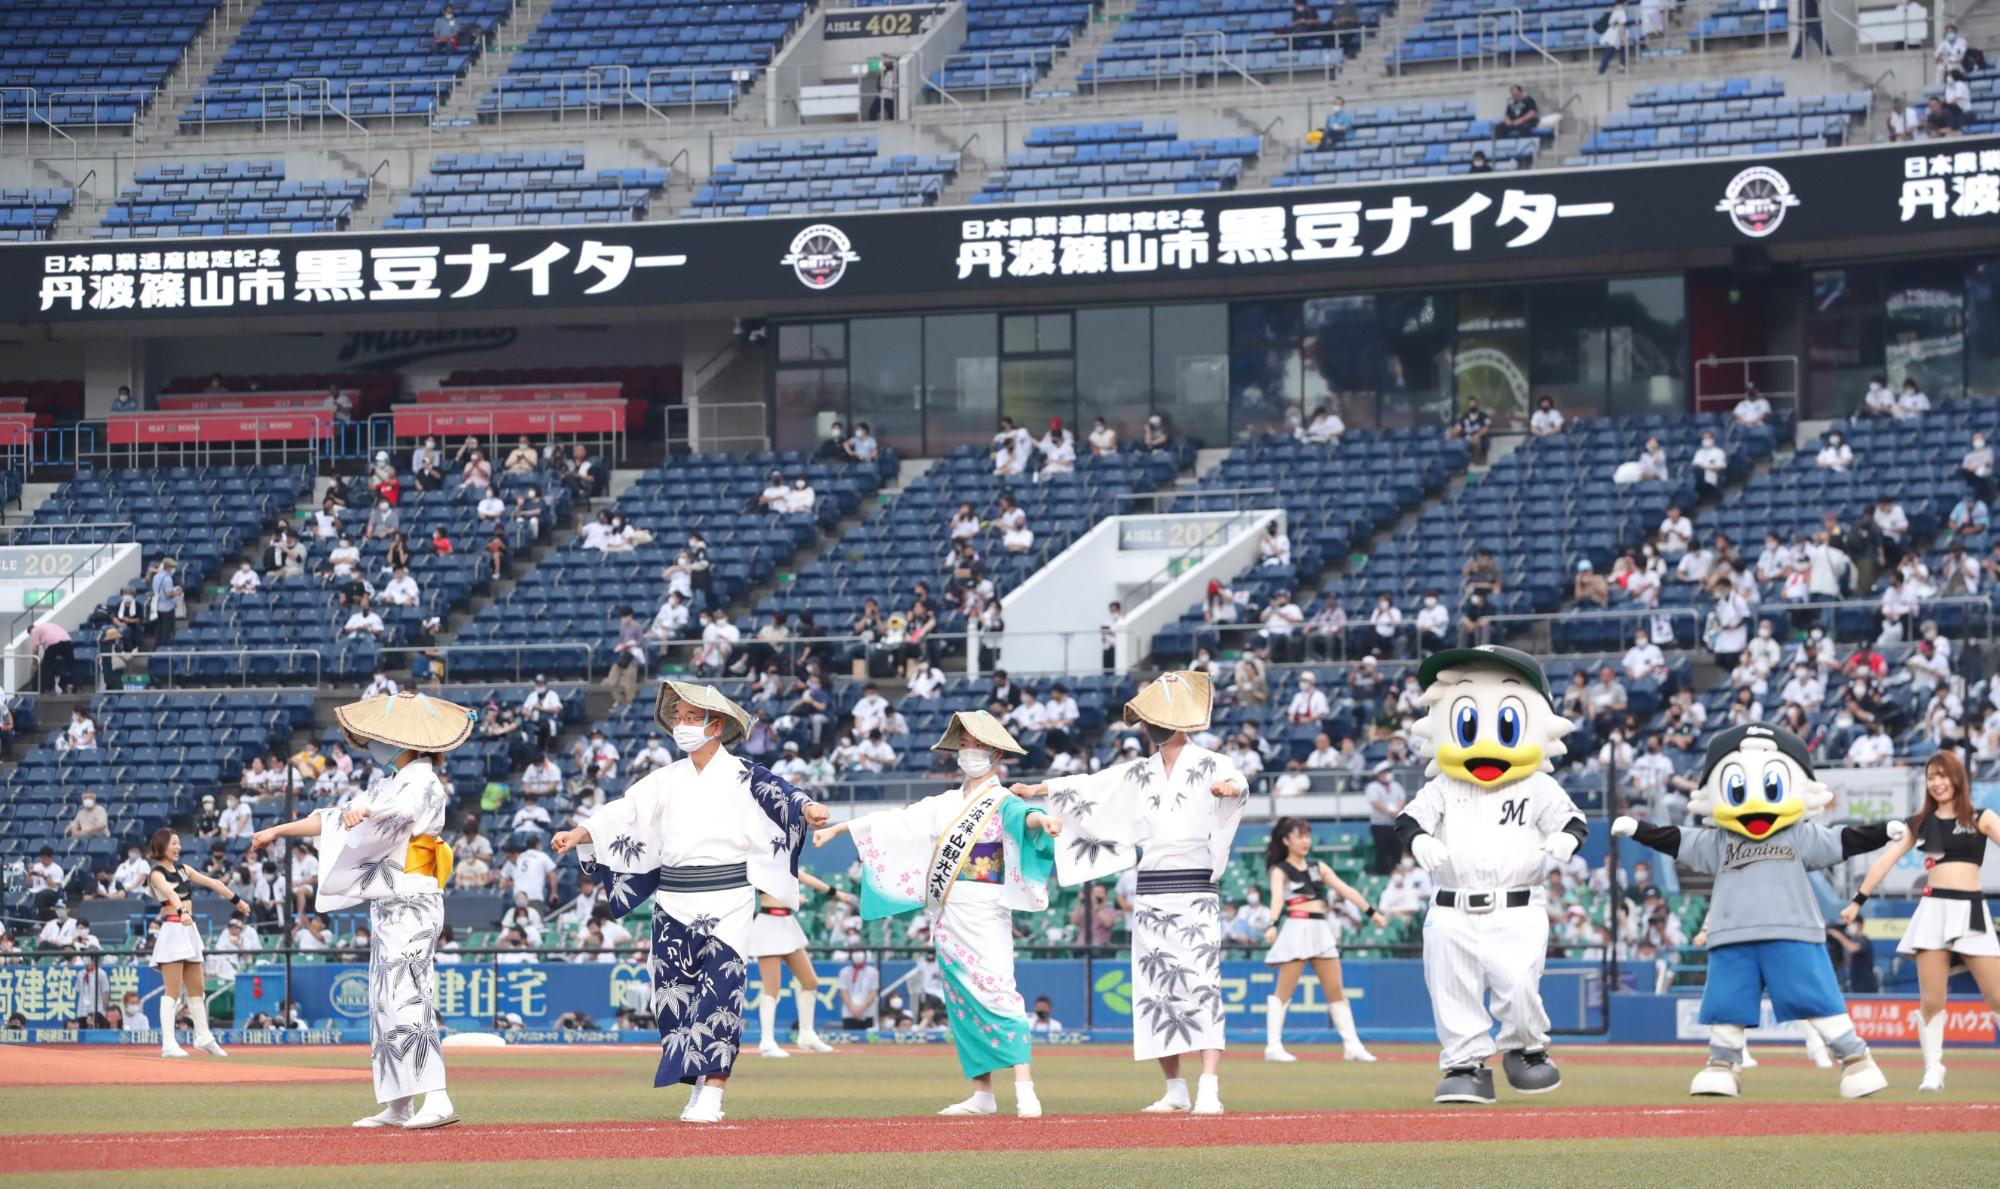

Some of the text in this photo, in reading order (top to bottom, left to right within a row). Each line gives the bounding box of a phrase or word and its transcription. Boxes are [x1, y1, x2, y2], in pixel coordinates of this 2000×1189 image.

[826, 21, 872, 32] AISLE
[875, 13, 912, 35] 402
[1898, 173, 2000, 222] 丹波
[957, 189, 1615, 279] 丹波篠山市 黒豆ナイター
[39, 240, 687, 311] 丹波篠山市 黒豆ナイター
[1168, 522, 1219, 545] 203
[0, 560, 17, 571] LE
[24, 553, 74, 576] 202
[1498, 797, 1529, 826] M
[929, 797, 996, 903] 丹波篠山観光大使
[1722, 839, 1797, 872] Marines
